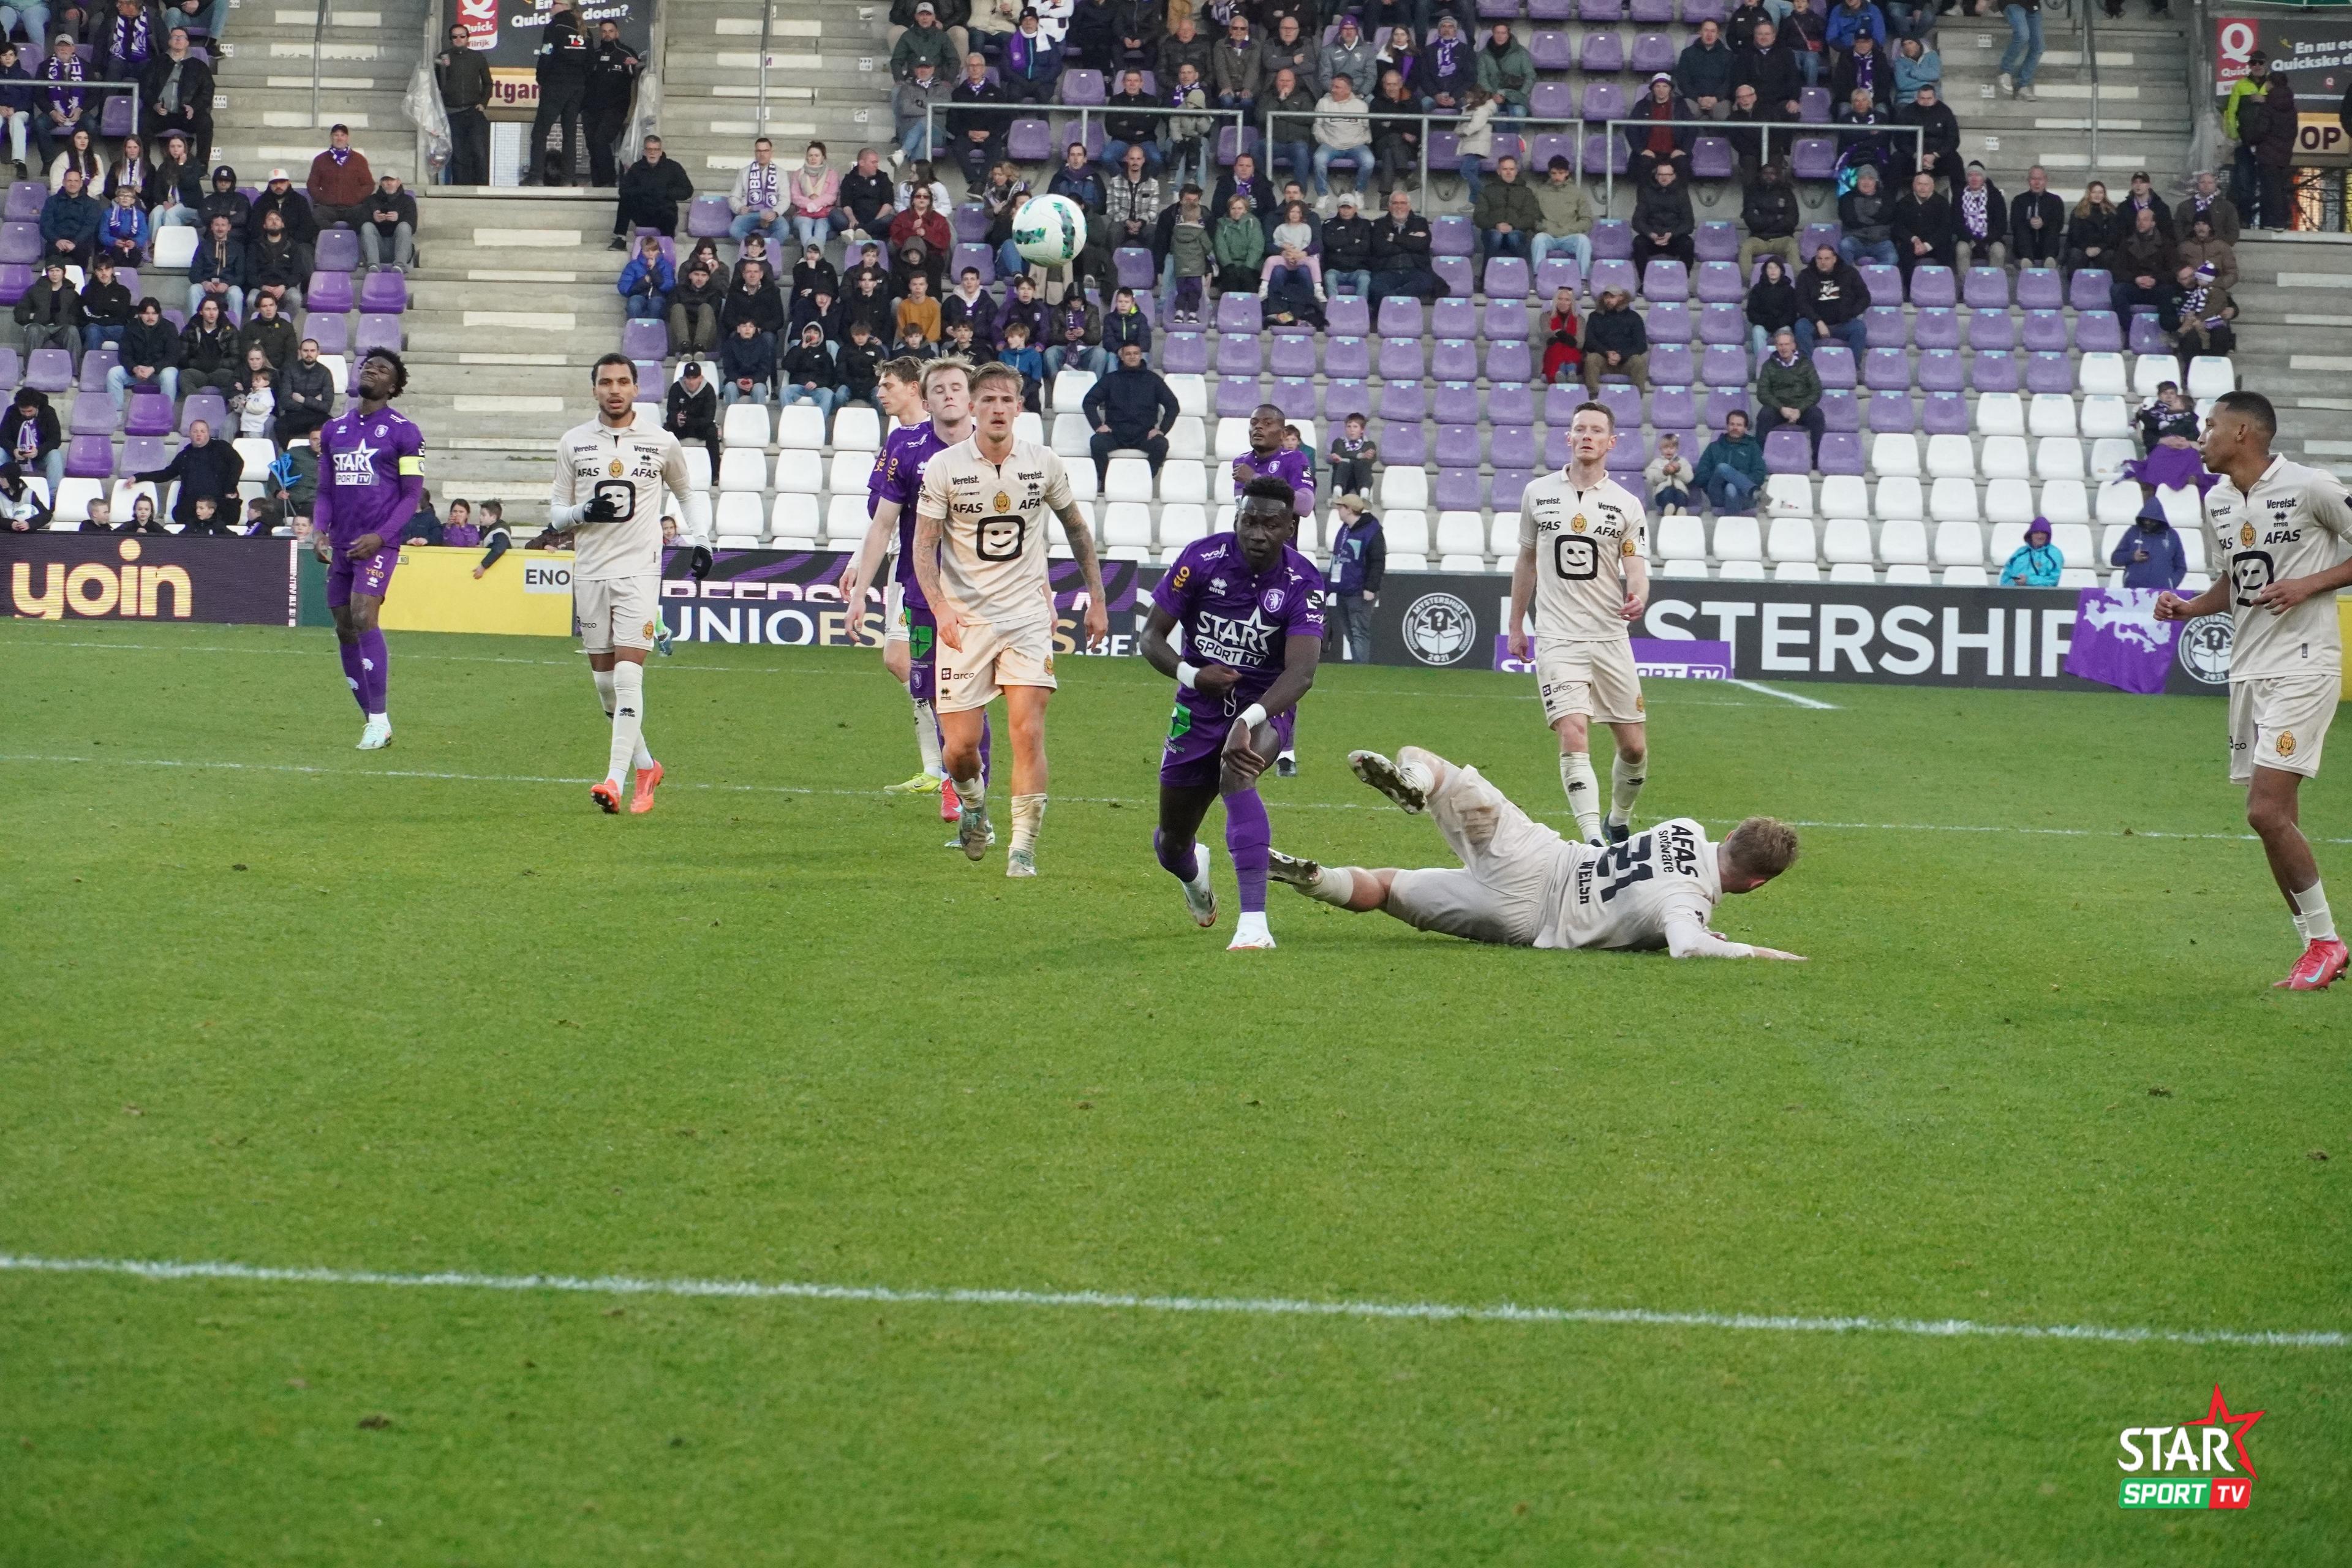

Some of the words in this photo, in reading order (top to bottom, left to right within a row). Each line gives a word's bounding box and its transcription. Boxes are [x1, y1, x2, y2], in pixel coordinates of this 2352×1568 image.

[582, 4, 628, 20] doen?
[568, 35, 584, 46] TS
[2222, 23, 2254, 62] Q
[2295, 42, 2314, 54] En
[2316, 40, 2336, 52] nu
[2271, 56, 2340, 72] Quickske
[2301, 126, 2341, 150] OP
[333, 454, 368, 471] STAR
[578, 467, 600, 477] AFAS
[630, 468, 658, 478] AFAS
[953, 503, 983, 514] AFAS
[2266, 497, 2297, 509] Verelst.
[1593, 526, 1623, 538] AFAS
[2264, 529, 2301, 545] AFAS
[374, 555, 384, 570] 5
[12, 539, 192, 620] yoin
[526, 569, 570, 586] ENO
[1196, 611, 1259, 654] STAR
[1197, 639, 1242, 662] SPORT
[1246, 655, 1263, 666] TV
[1658, 830, 1674, 873] software
[1672, 824, 1698, 878] AFAS
[1596, 834, 1654, 903] 21
